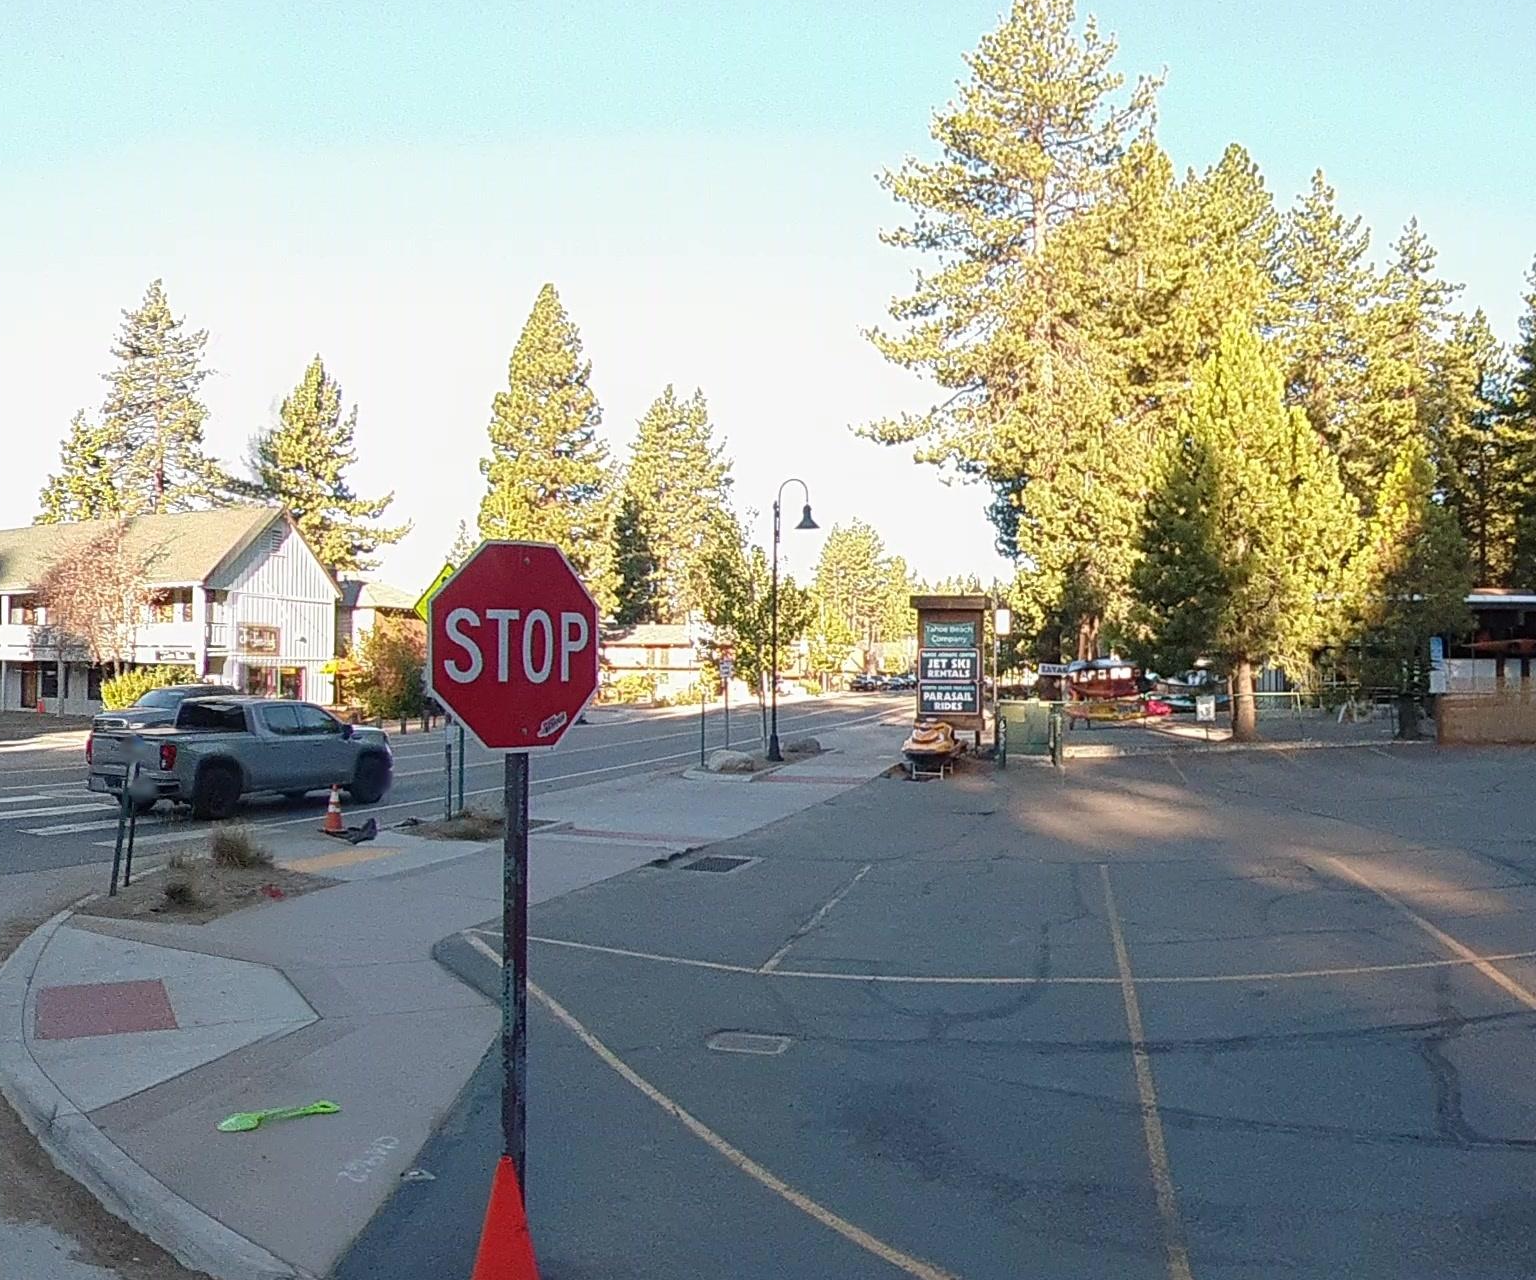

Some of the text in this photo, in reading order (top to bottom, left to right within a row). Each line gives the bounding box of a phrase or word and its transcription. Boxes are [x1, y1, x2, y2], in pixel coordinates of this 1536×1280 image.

[926, 625, 973, 634] Tahoe Beach
[930, 634, 968, 645] Company
[444, 607, 589, 684] STOP
[927, 658, 971, 669] JET SKI
[927, 669, 971, 678] RENTALS
[923, 691, 974, 701] PARASAIL
[933, 702, 963, 711] RIDES
